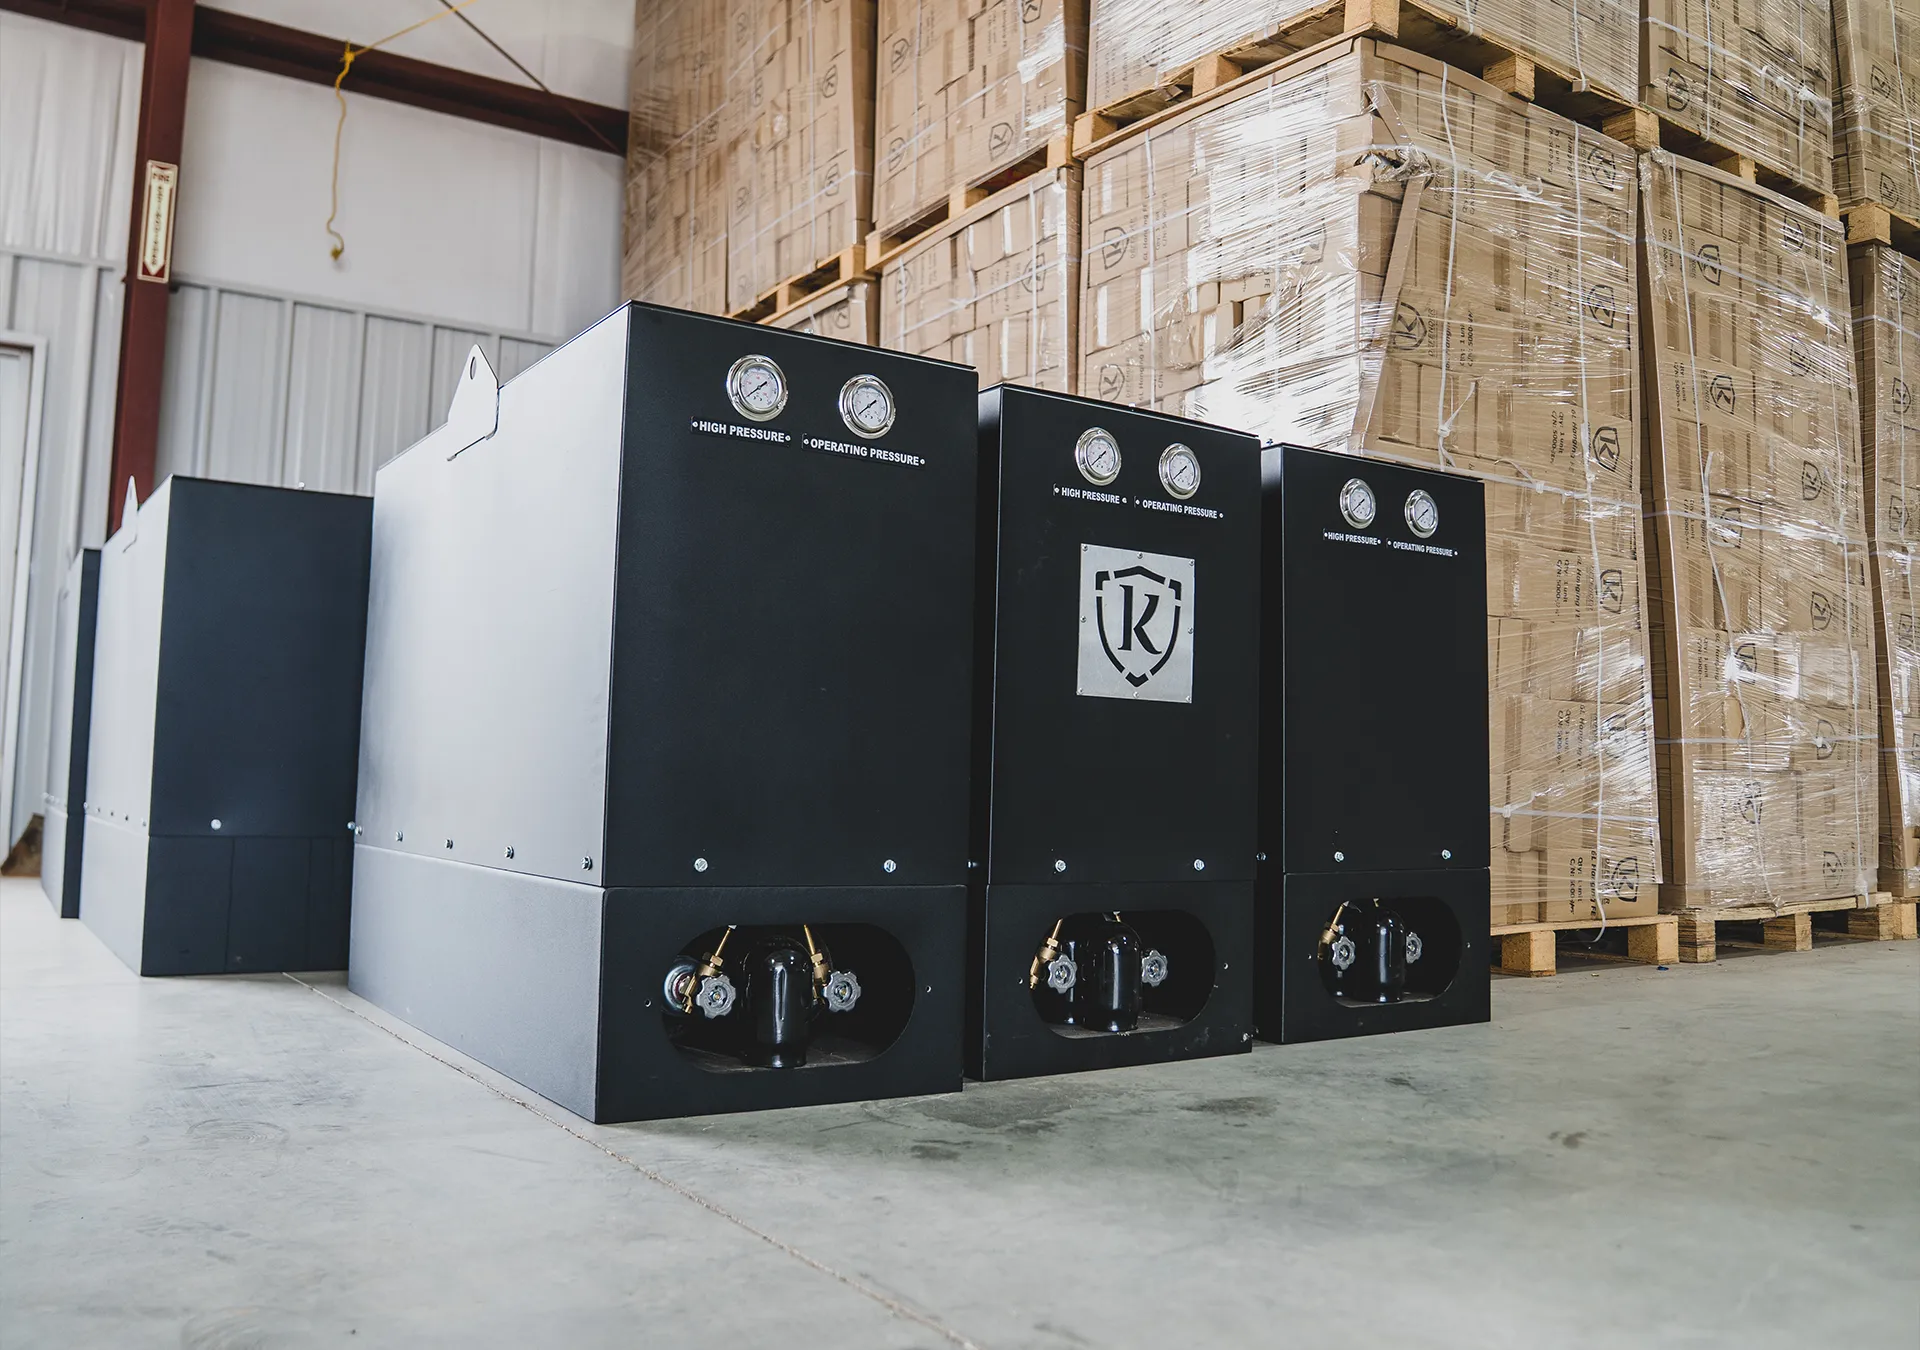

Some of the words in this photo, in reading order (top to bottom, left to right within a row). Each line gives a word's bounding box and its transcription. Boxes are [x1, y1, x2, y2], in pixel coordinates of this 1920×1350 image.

[699, 420, 726, 435] HIGH
[729, 424, 785, 443] PRESSURE
[1570, 422, 1578, 459] Hanging
[810, 438, 868, 458] OPERATING
[869, 446, 919, 466] PRESSURE
[1061, 486, 1081, 499] HIGH
[1082, 490, 1120, 504] PRESSURE
[1142, 499, 1183, 514] OPERATING
[1183, 505, 1218, 519] PRESSURE
[1328, 531, 1344, 542] HIGH
[1345, 534, 1377, 546] PRESSURE
[1393, 541, 1425, 553] OPERATING
[1425, 545, 1453, 557] PRESSURE
[1591, 851, 1596, 861] 6L
[1591, 906, 1596, 916] FE
